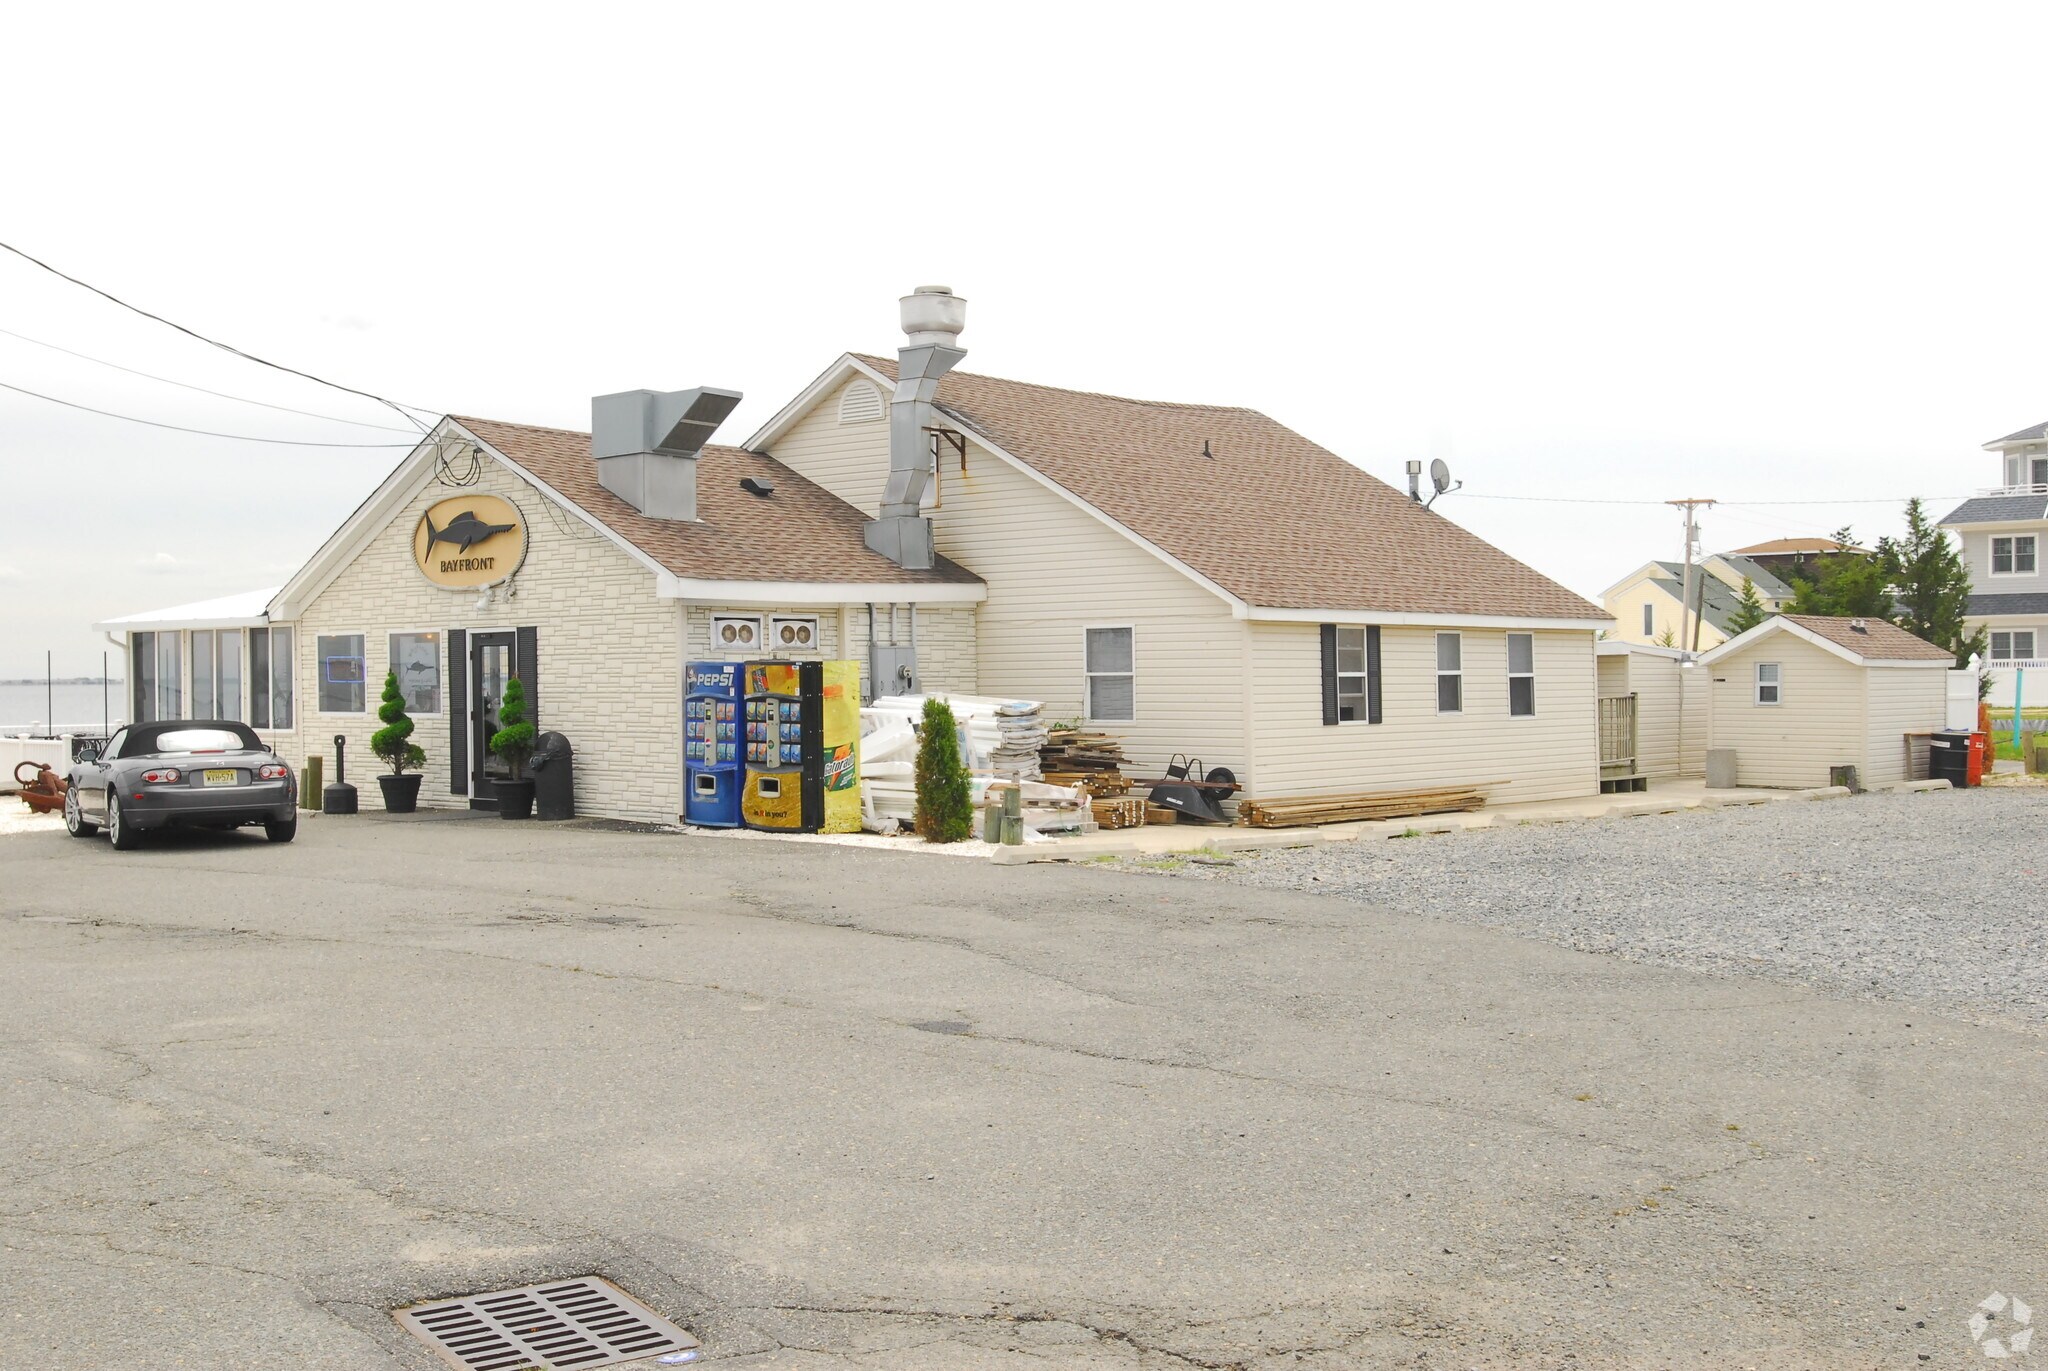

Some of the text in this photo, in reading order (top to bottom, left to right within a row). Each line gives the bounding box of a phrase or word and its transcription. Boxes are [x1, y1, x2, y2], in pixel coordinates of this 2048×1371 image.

[440, 557, 494, 573] BAYFRONT
[697, 673, 733, 687] PEPSI
[772, 810, 787, 819] you?
